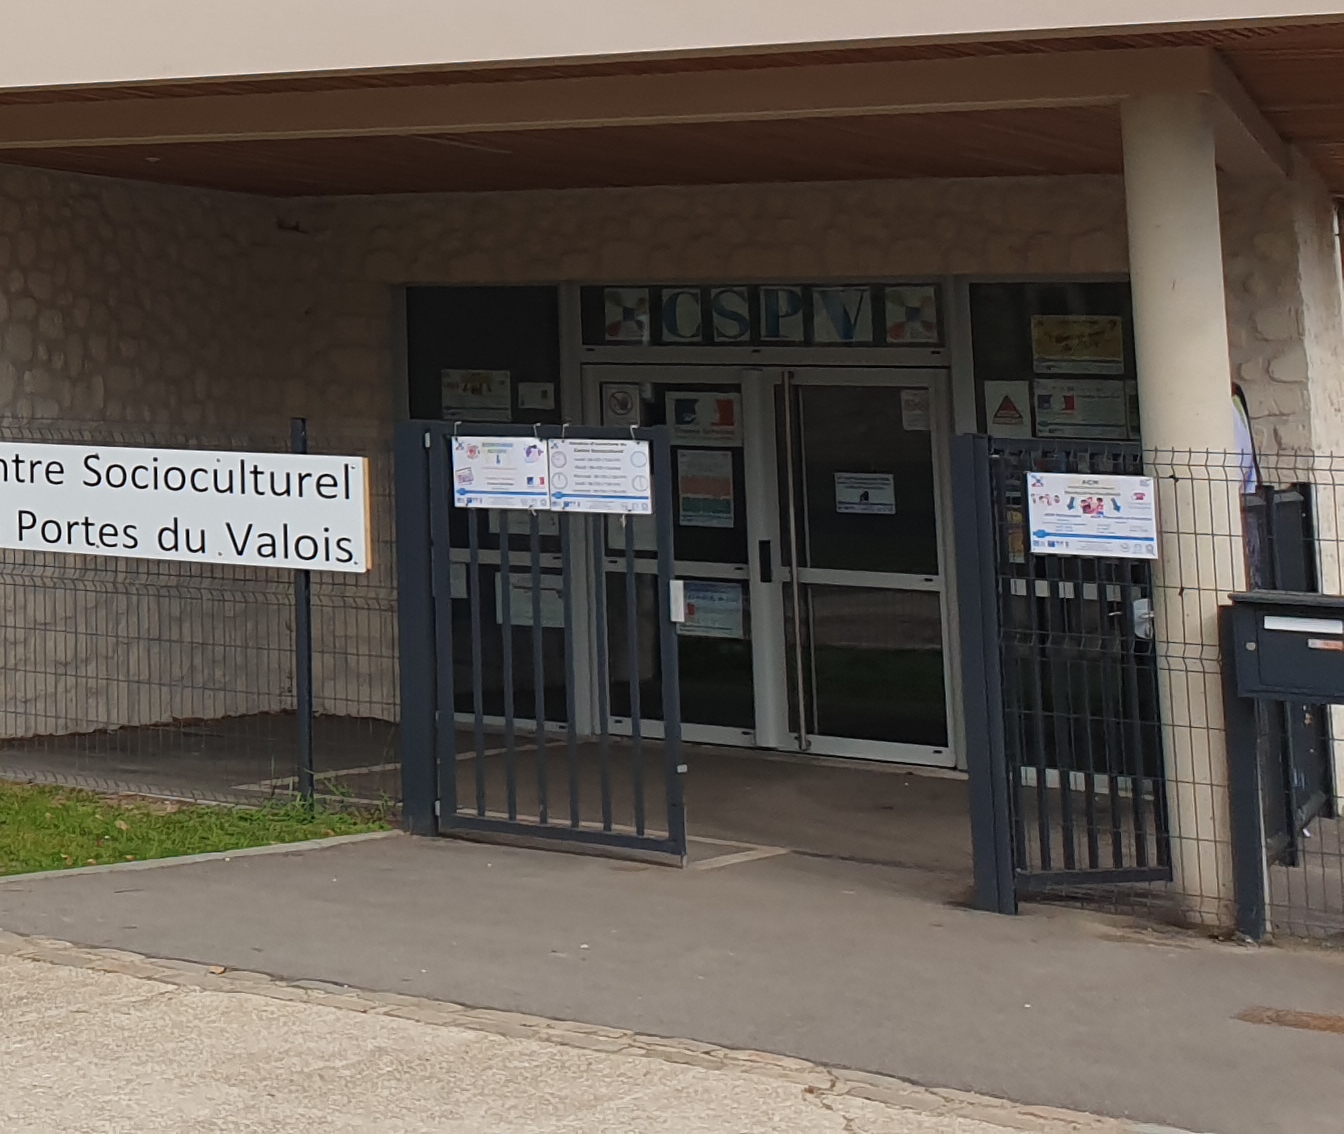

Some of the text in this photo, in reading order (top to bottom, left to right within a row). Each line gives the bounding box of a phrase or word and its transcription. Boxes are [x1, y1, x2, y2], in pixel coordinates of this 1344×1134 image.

[662, 288, 868, 341] CSPV
[82, 452, 352, 500] Socioculturel
[17, 509, 139, 550] Portes
[156, 517, 207, 554] du
[225, 522, 354, 564] Valois
